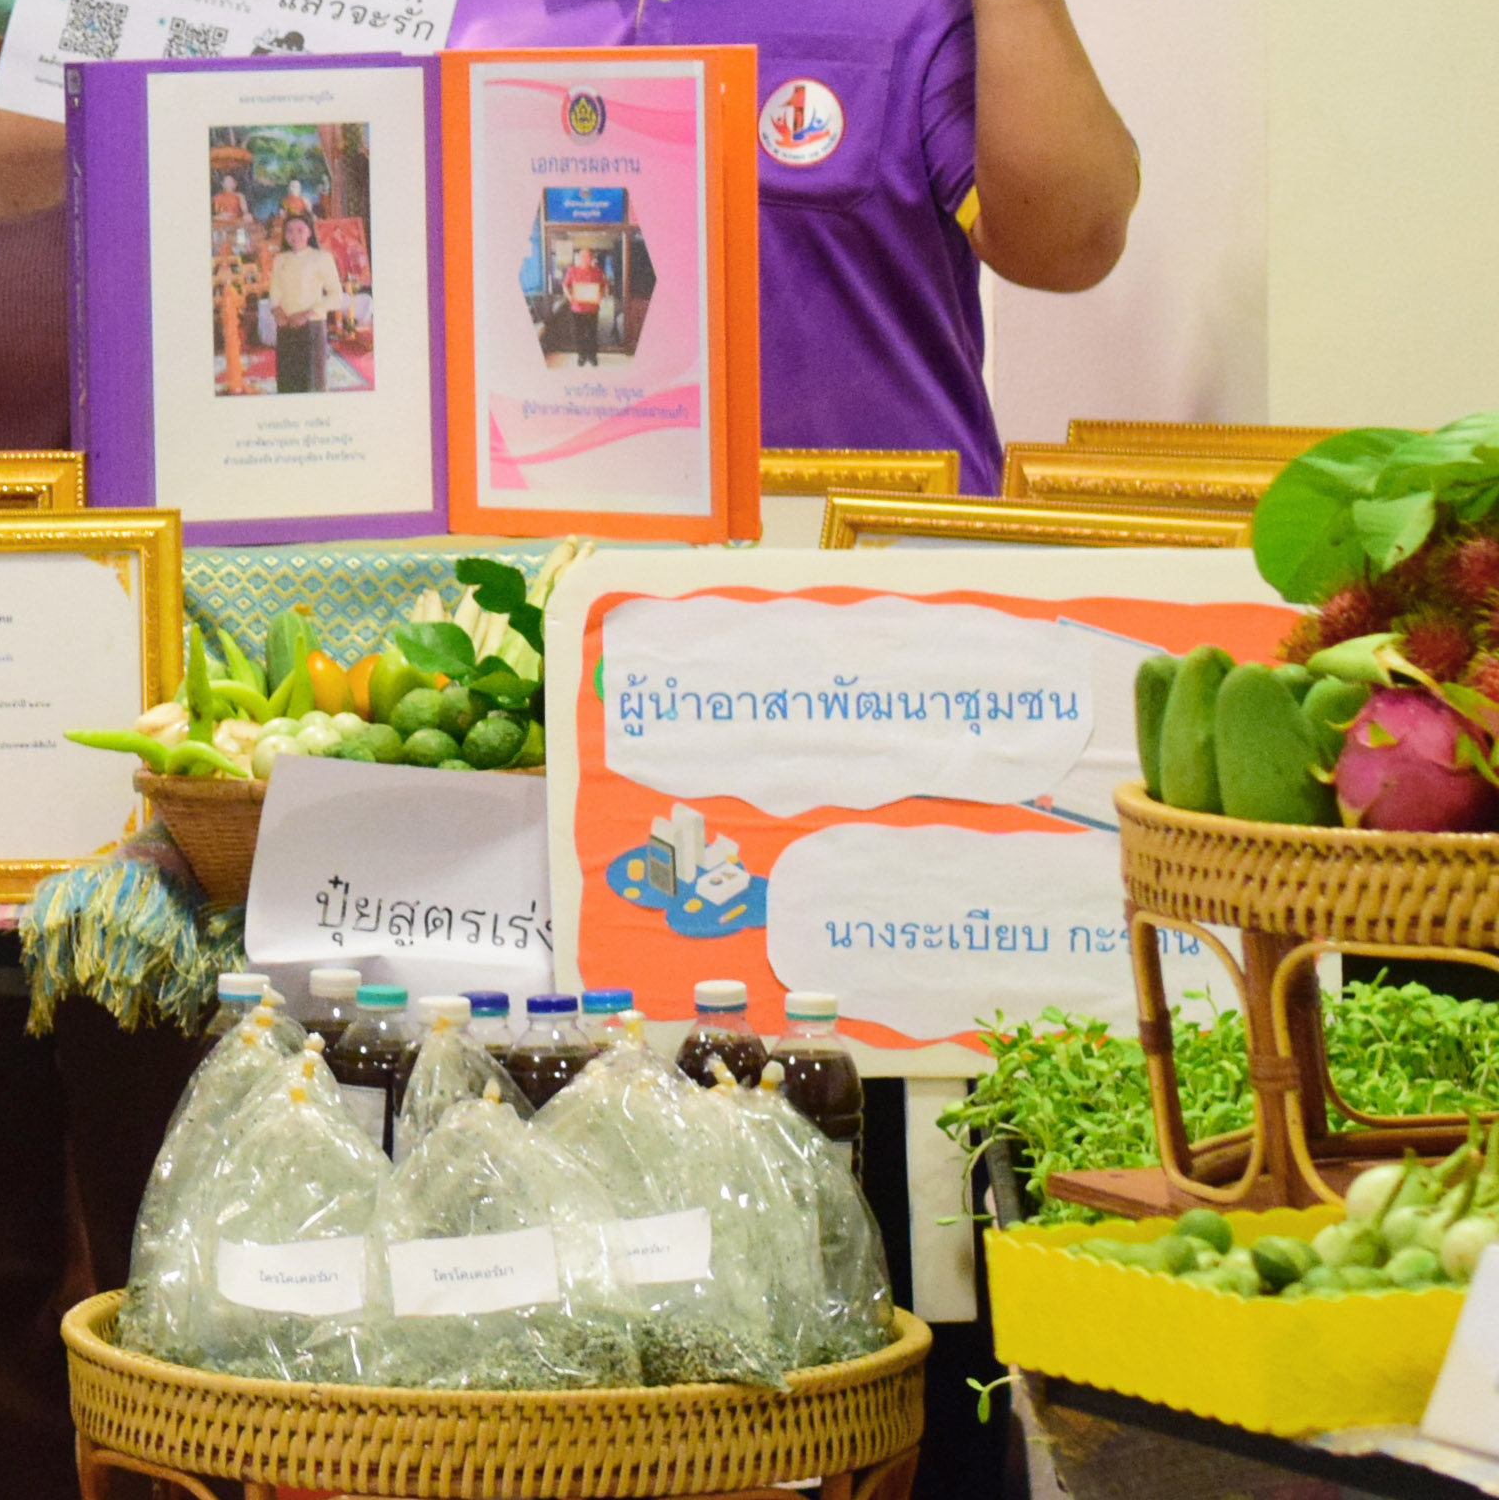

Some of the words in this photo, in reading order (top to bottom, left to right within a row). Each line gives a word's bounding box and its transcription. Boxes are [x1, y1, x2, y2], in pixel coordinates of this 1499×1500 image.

[531, 157, 641, 174] เอกสารผลงาน
[618, 678, 1080, 739] ผู้นำอาสาพัฒนาชุมชน
[825, 908, 1049, 956] นางระเบียบ
